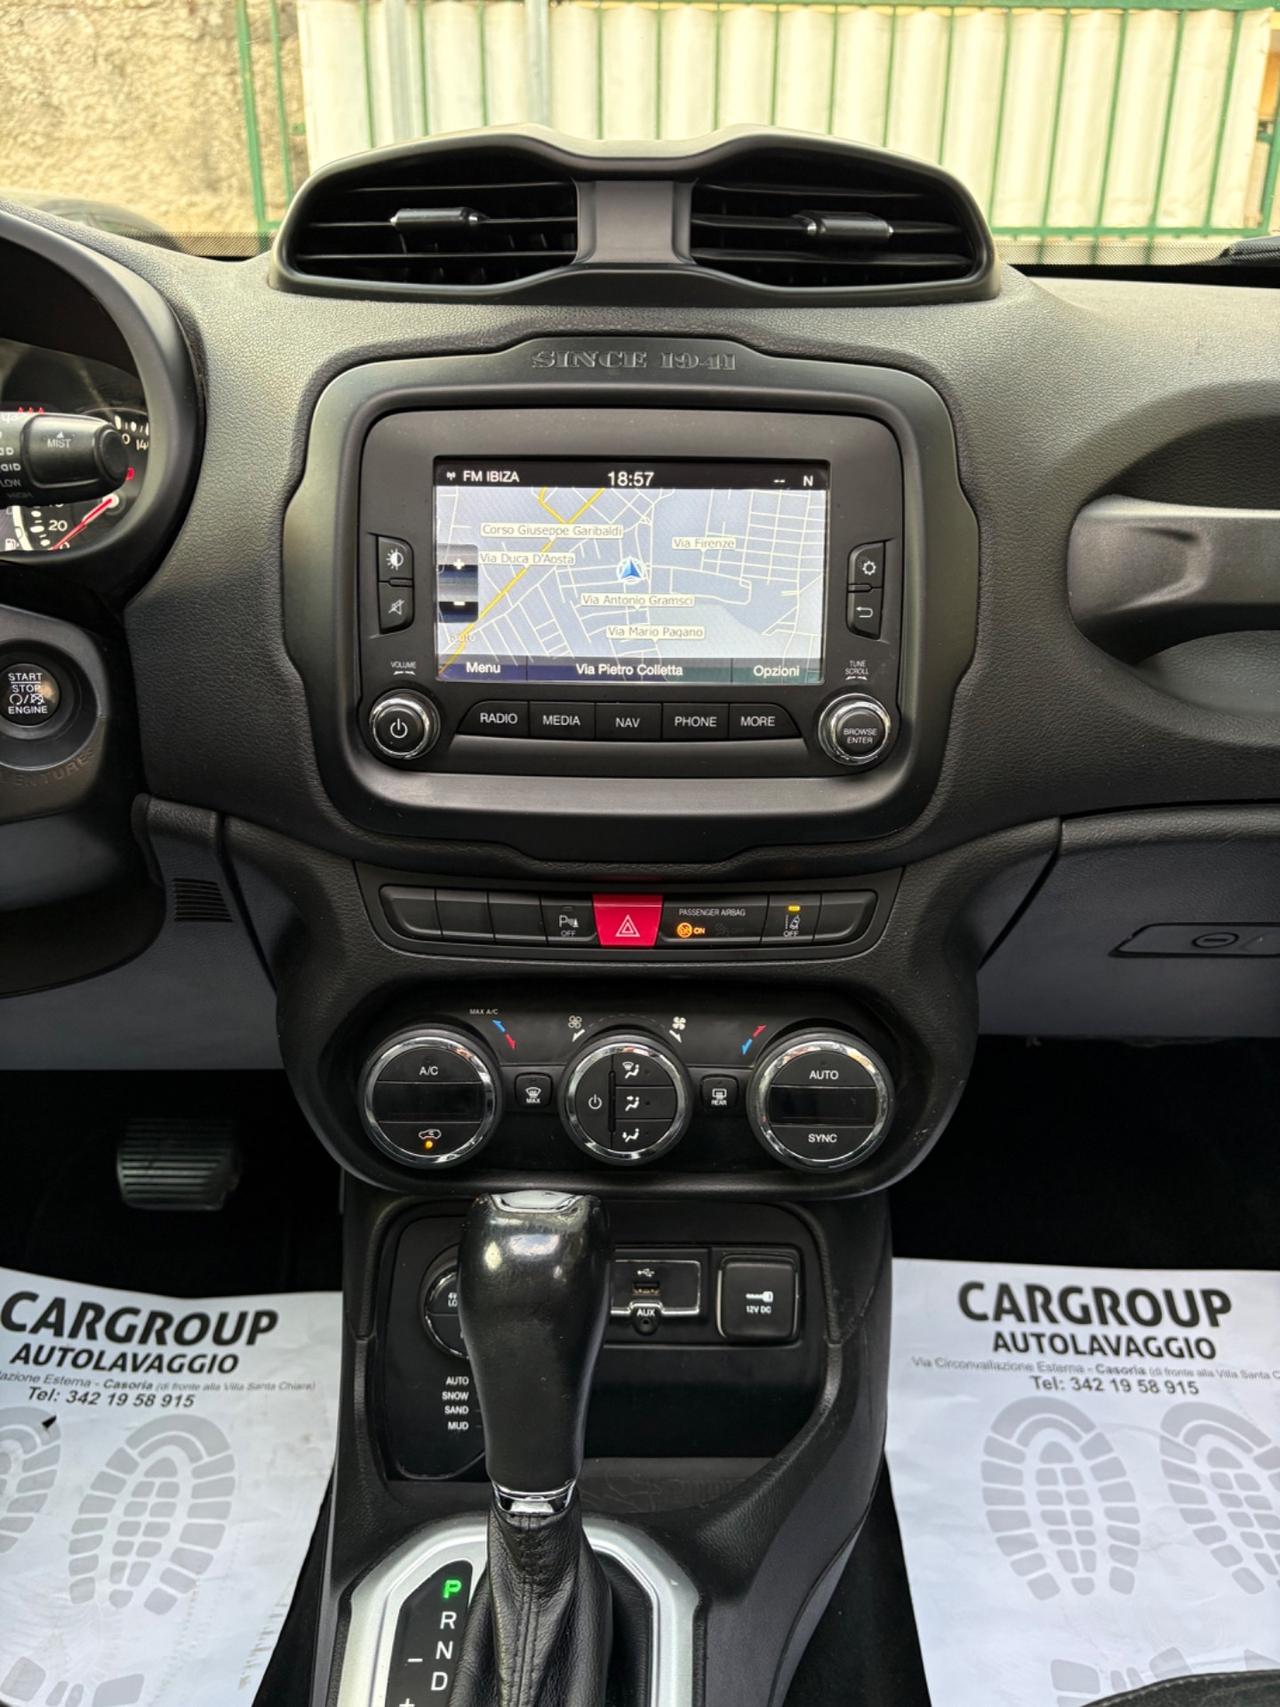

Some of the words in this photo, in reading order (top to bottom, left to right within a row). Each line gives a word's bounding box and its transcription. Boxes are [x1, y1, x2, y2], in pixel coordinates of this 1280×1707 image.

[532, 351, 647, 368] SINCE
[660, 352, 736, 370] 1941
[47, 438, 71, 448] MIST
[463, 470, 482, 482] FM
[487, 471, 520, 483] IBIZA
[608, 471, 654, 486] 18:57
[803, 475, 814, 486] N
[49, 520, 67, 531] 20
[482, 525, 515, 536] Corso
[517, 526, 569, 538] Giuseppe
[573, 526, 622, 537] Garibaldi
[674, 538, 691, 547] Via
[695, 538, 735, 548] Firenze
[480, 553, 500, 562] Via
[502, 553, 528, 563] Duca
[533, 554, 574, 564] D'Aosta
[582, 595, 600, 604] Via
[603, 595, 646, 605] Antonio
[650, 596, 693, 605] Gramsci
[608, 627, 625, 636] Via
[629, 628, 659, 637] Mario
[663, 628, 703, 639] Pagano
[391, 661, 416, 669] VOLUME
[466, 662, 501, 673] Menu
[576, 664, 594, 675] Via
[598, 664, 632, 675] Pietro
[637, 664, 683, 676] Colletta
[753, 665, 800, 677] Opzioni
[8, 673, 42, 681] START
[12, 685, 41, 693] STOP
[8, 706, 48, 715] ENGINE
[480, 713, 518, 724] RADIO
[543, 715, 581, 726] MEDIA
[615, 718, 640, 728] NAV
[674, 716, 717, 727] PHONE
[740, 716, 775, 727] MORE
[843, 728, 878, 736] BROWSE
[679, 908, 718, 917] PASSENGER
[721, 909, 746, 917] AIRBAG
[694, 927, 705, 935] ON
[419, 1066, 438, 1076] A/C
[809, 1070, 839, 1080] AUTO
[808, 1134, 837, 1143] SYNC
[746, 1306, 758, 1314] 12V
[760, 1306, 771, 1314] DC
[958, 1281, 1232, 1328] CARGROUP
[1, 1291, 278, 1346] CARGROUP
[637, 1309, 655, 1317] AUX
[993, 1331, 1216, 1360] AUTOLAVAGGIO
[10, 1343, 239, 1374] AUTOLAVAGGIO
[912, 1356, 931, 1367] Via
[935, 1357, 1033, 1372] Circonvallazione
[1037, 1361, 1084, 1374] Esterna
[1095, 1363, 1146, 1376] Casoria
[1240, 1369, 1271, 1380] Santa
[103, 1378, 153, 1390] Casoria
[446, 1376, 469, 1385] AUTO
[1030, 1375, 1065, 1391] Tel:
[1071, 1377, 1104, 1393] 342
[1110, 1378, 1132, 1393] 19
[1137, 1378, 1159, 1394] 58
[1164, 1379, 1199, 1395] 915
[28, 1386, 60, 1402] Tel:
[66, 1390, 101, 1406] 342
[107, 1392, 128, 1407] 19
[133, 1393, 154, 1408] 58
[160, 1393, 196, 1408] 915
[442, 1391, 469, 1400] SNOW
[444, 1405, 469, 1414] SAND
[448, 1421, 469, 1430] MUD
[443, 1579, 462, 1599] P
[440, 1611, 457, 1629] R
[435, 1641, 453, 1659] N
[431, 1671, 448, 1691] D
